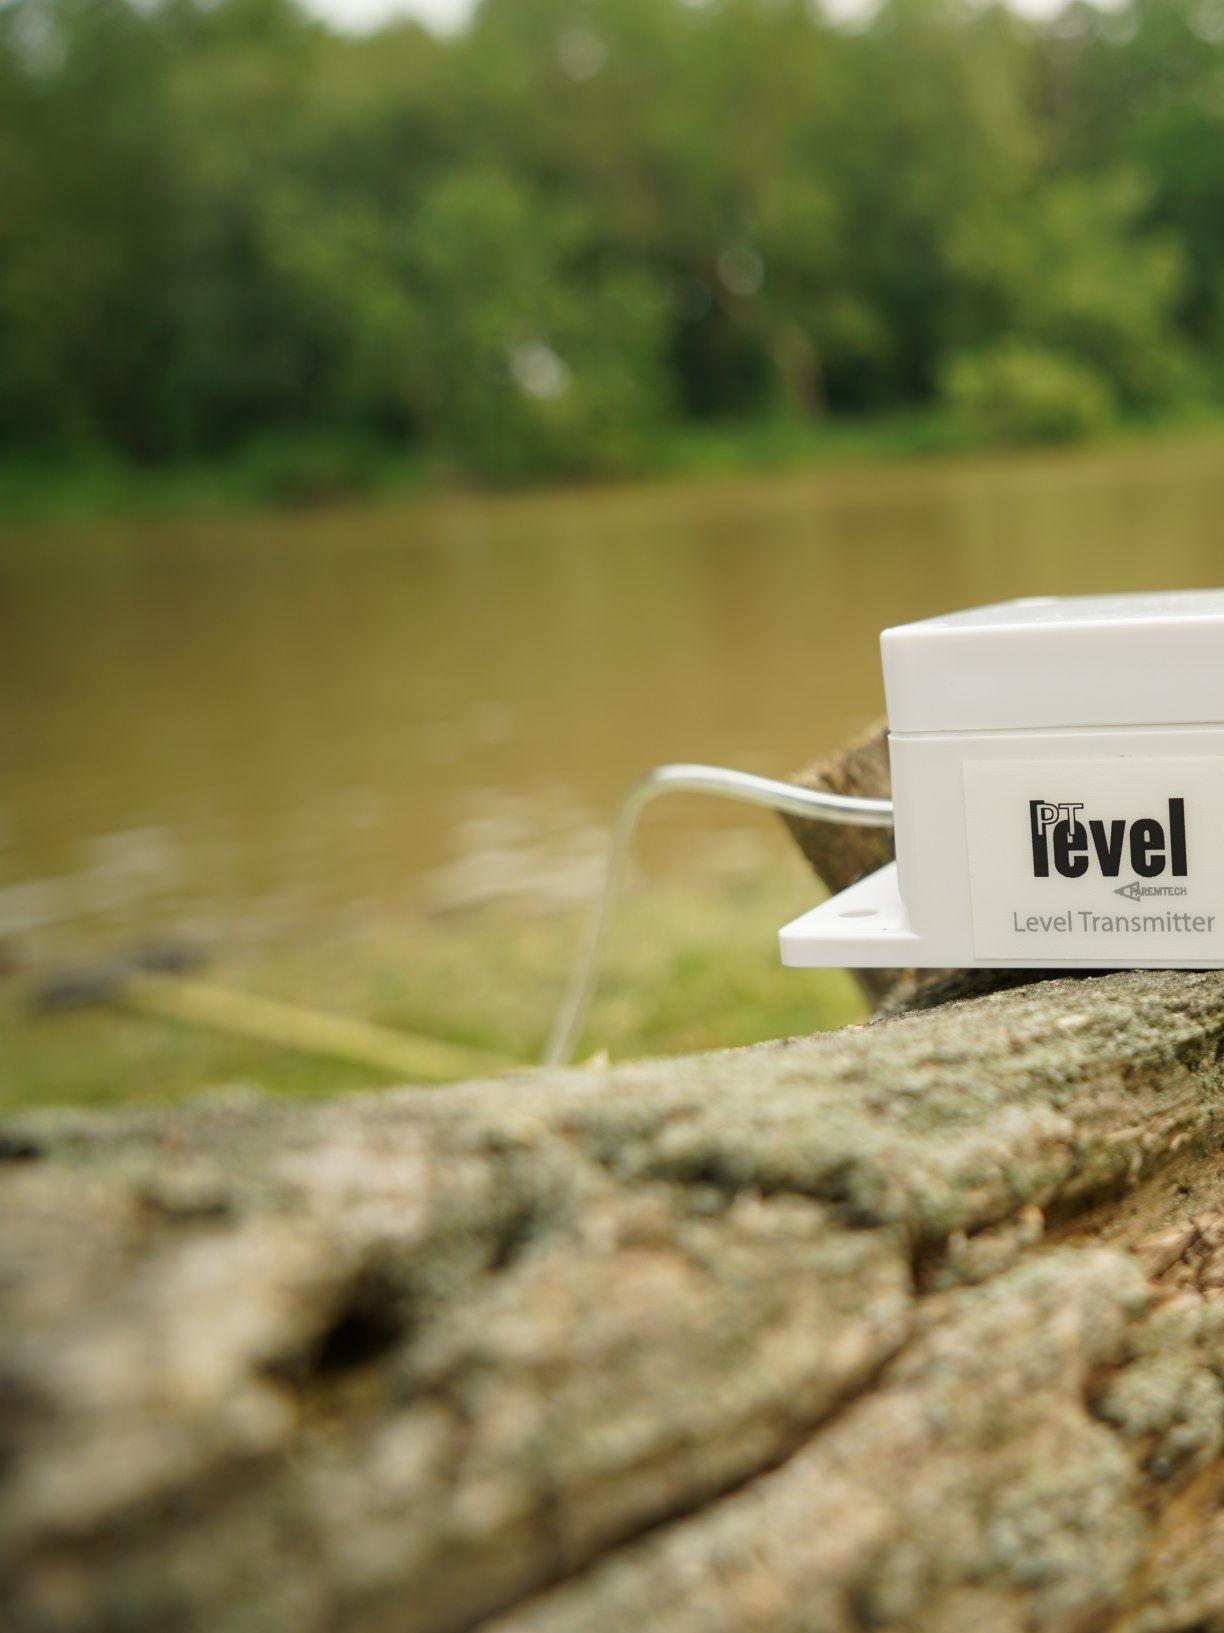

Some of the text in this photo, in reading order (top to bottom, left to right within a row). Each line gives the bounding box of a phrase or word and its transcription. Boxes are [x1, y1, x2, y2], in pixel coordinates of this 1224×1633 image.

[1036, 803, 1084, 836] PT
[1029, 797, 1188, 878] level
[1129, 886, 1187, 897] PAREMTECH
[1013, 910, 1215, 932] Level Transmitter
